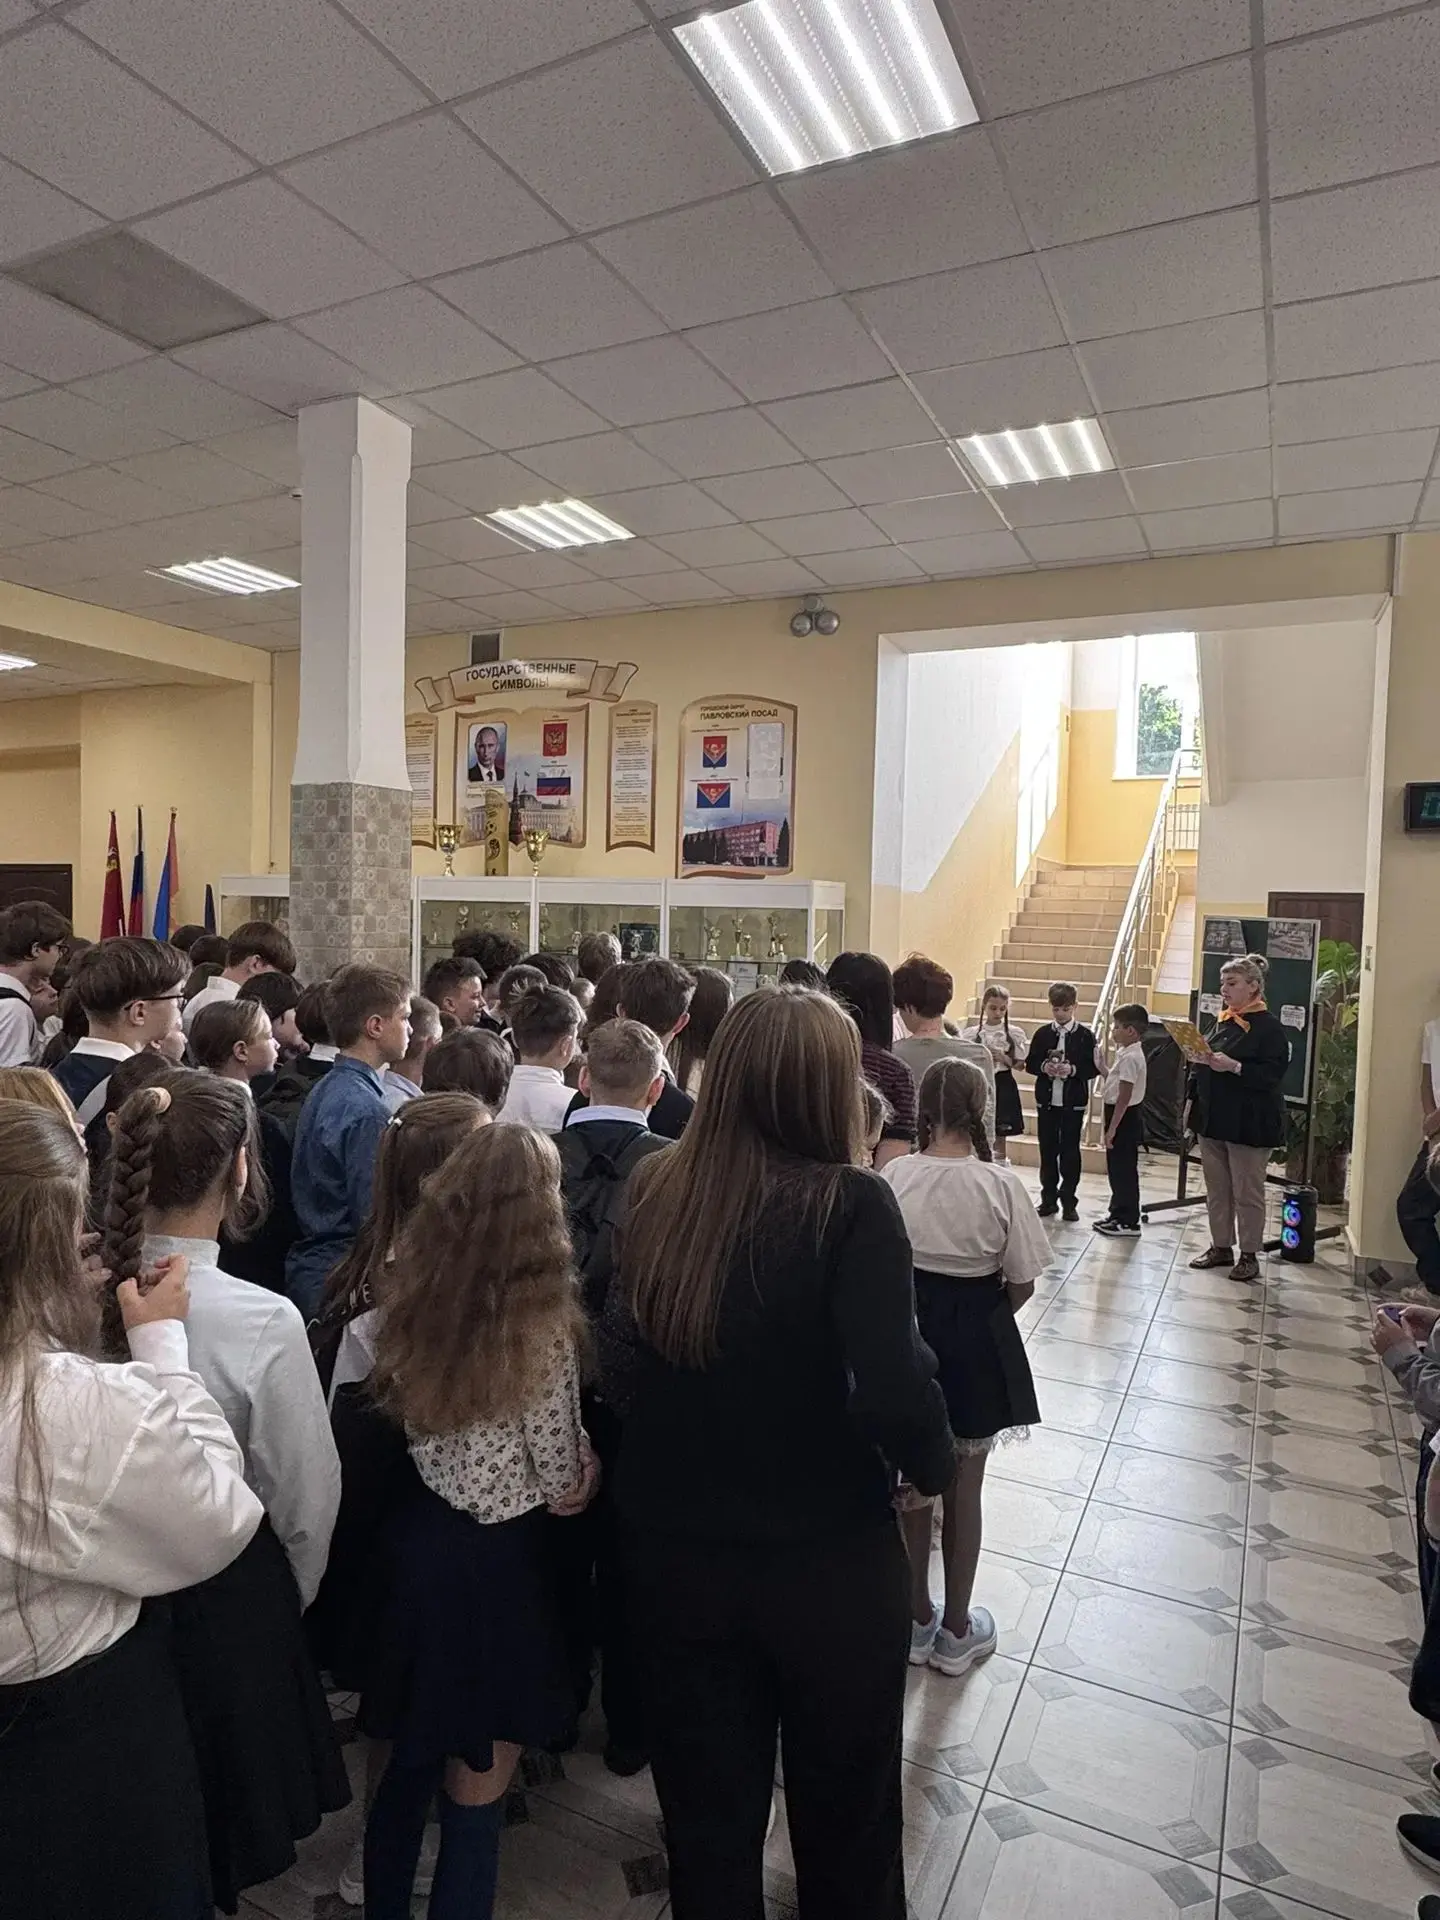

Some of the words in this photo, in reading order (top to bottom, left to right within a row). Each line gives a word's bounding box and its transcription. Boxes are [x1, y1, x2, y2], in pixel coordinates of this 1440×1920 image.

[466, 663, 577, 682] ГОСУДАРСТВЕННЫЕ
[700, 708, 749, 720] ПАВЛОВСКИЙ
[751, 709, 778, 718] ПОСАД
